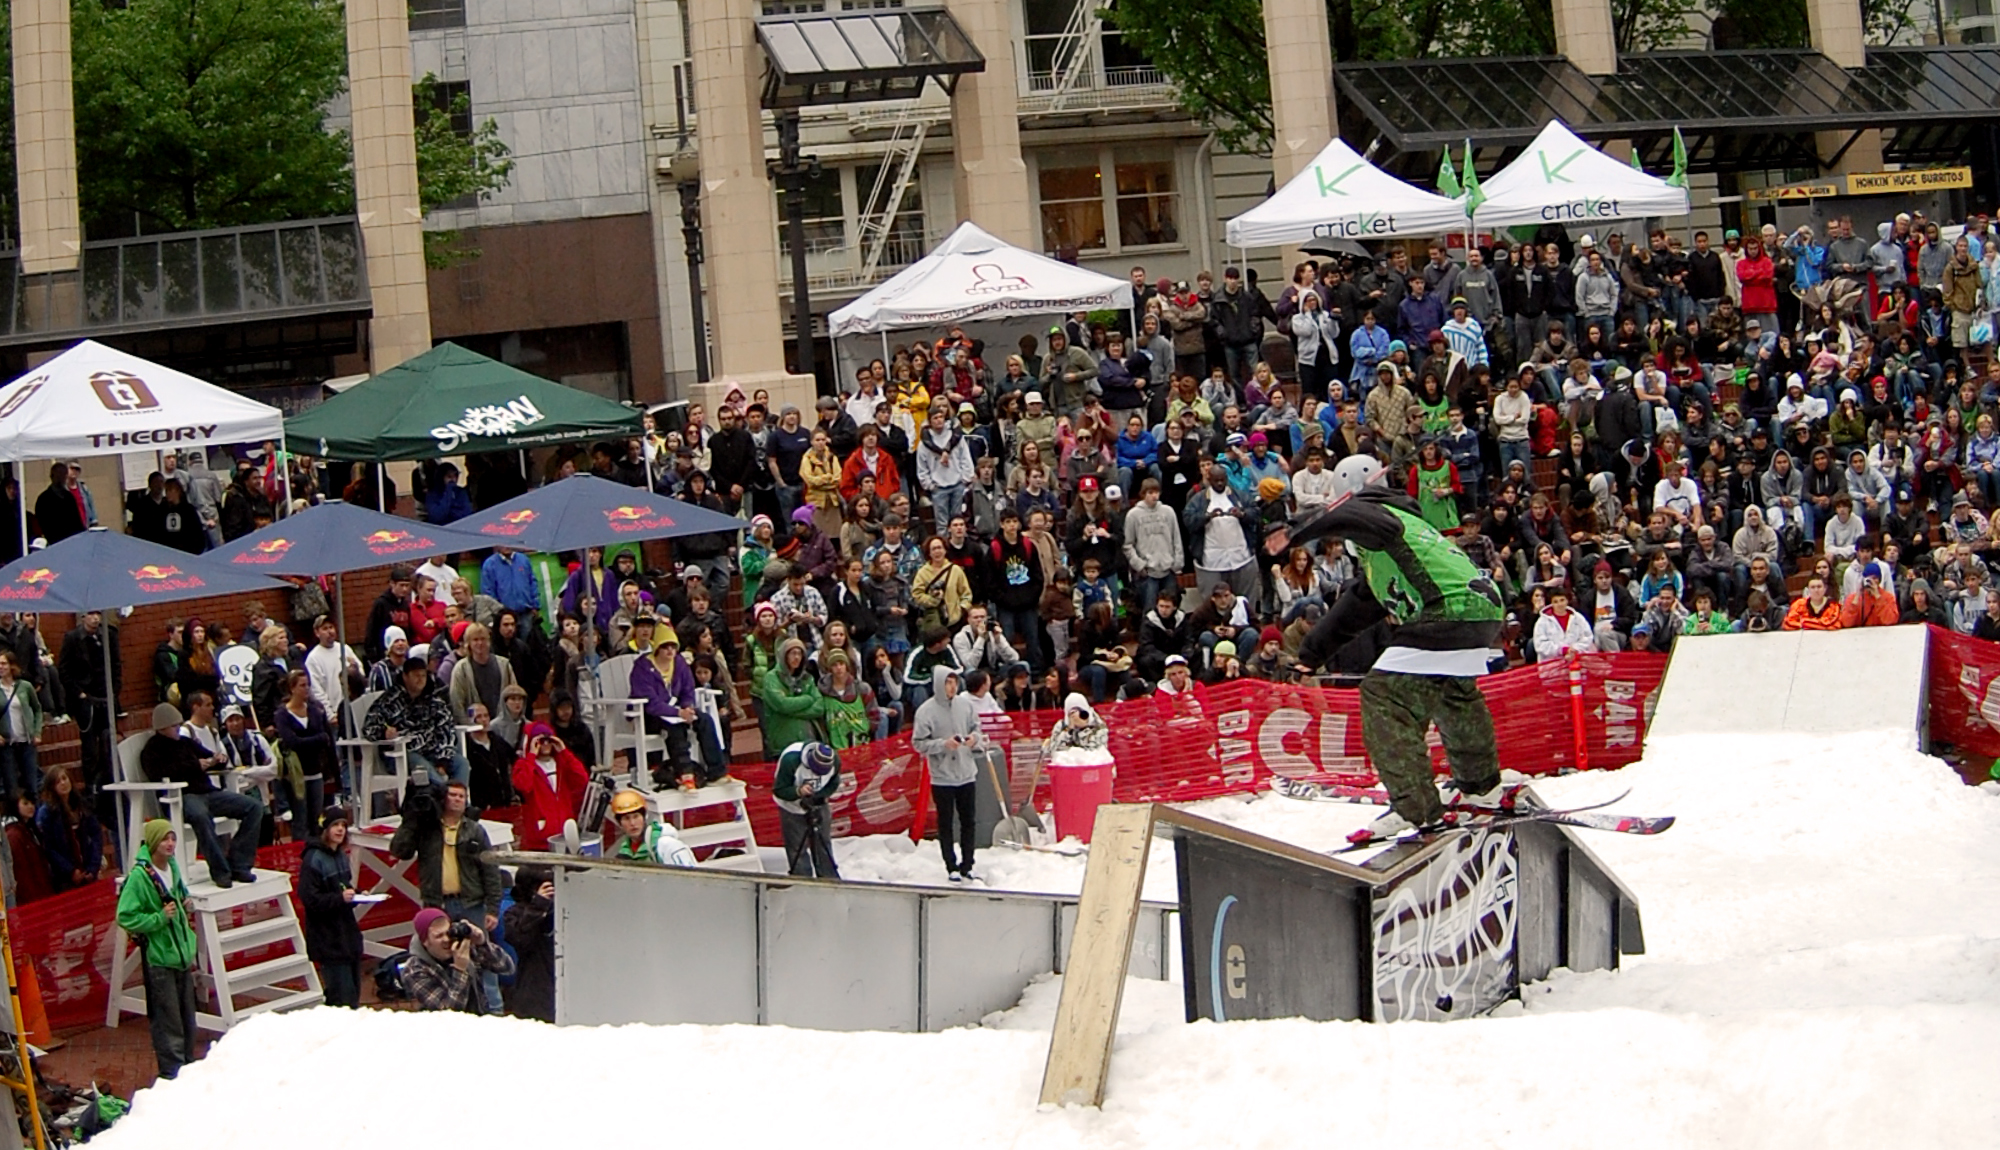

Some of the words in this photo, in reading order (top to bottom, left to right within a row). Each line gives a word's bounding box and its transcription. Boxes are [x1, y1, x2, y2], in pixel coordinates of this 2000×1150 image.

[1855, 175, 1892, 189] HONKIN'
[1893, 174, 1917, 186] HUGE
[1921, 172, 1965, 184] BURRITOS
[964, 284, 1032, 295] CIVIL
[86, 424, 217, 448] THEORY
[1604, 679, 1637, 750] BAR
[1217, 709, 1255, 787] BAR
